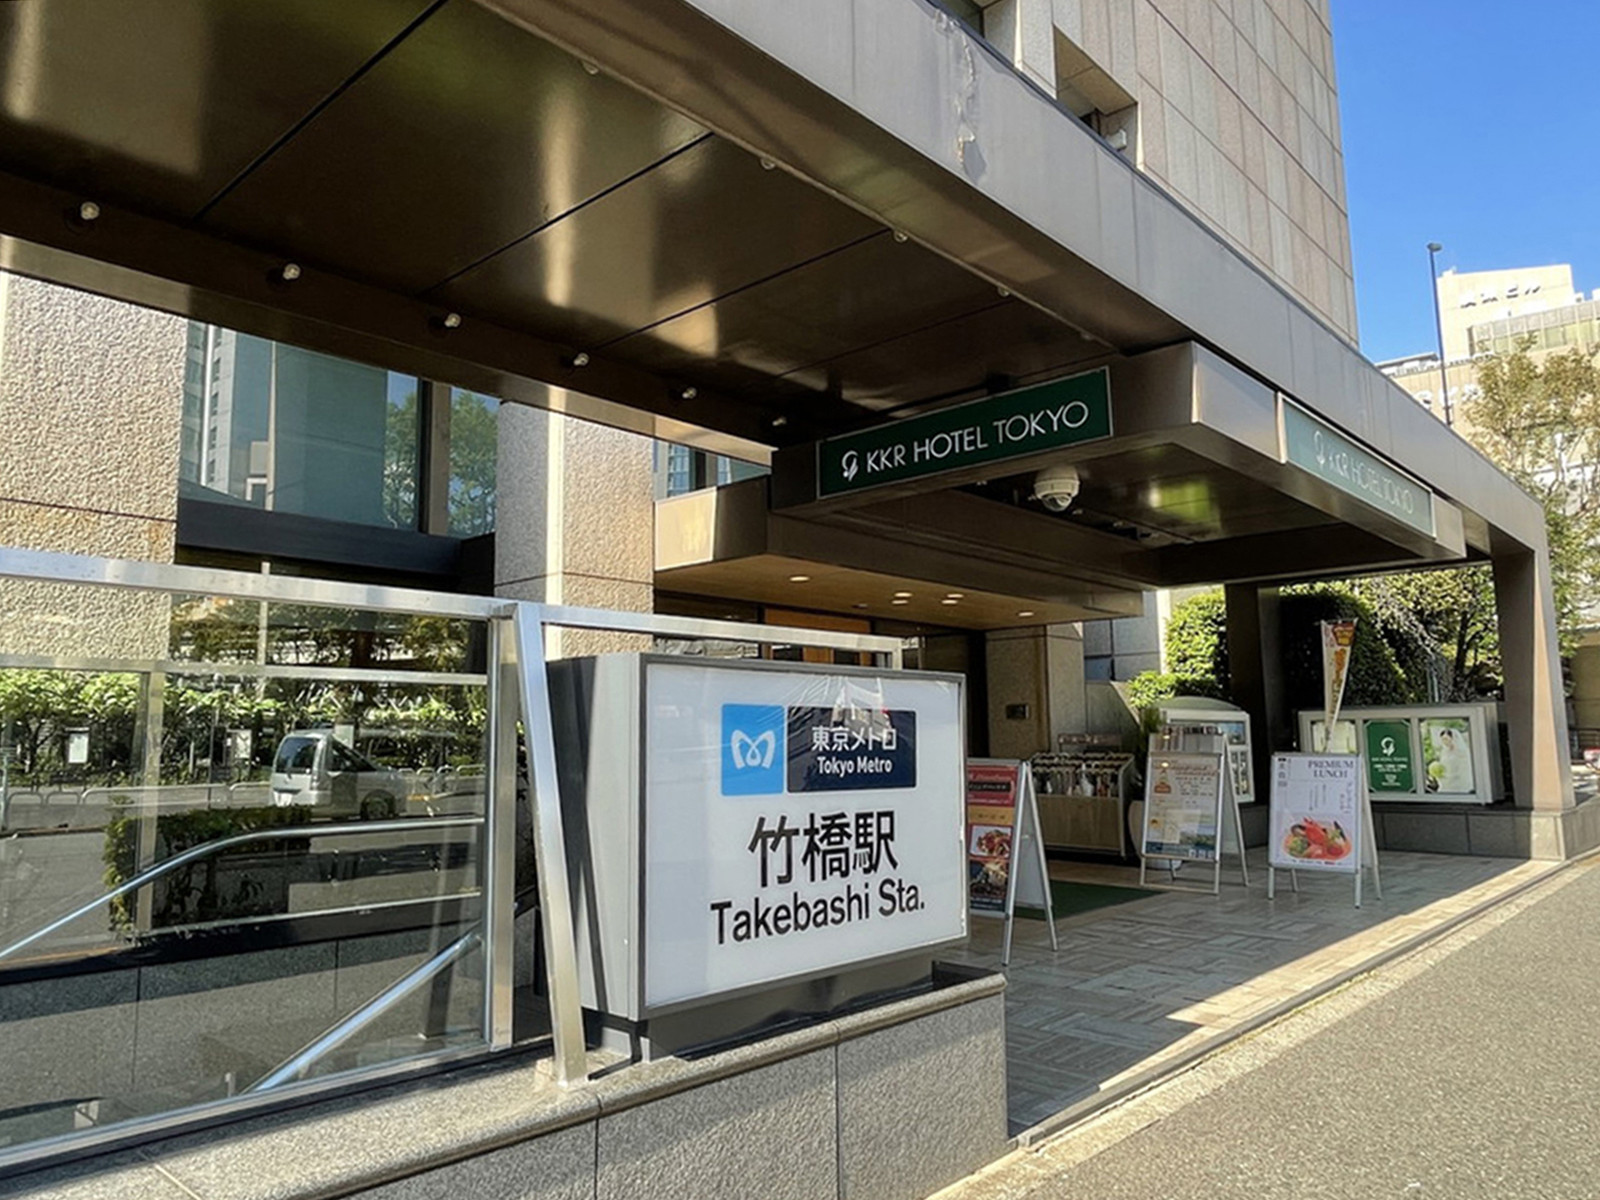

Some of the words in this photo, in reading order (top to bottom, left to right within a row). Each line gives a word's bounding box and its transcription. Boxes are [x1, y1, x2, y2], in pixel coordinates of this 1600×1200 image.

[866, 444, 907, 473] KKR
[913, 426, 988, 463] HOTEL
[993, 400, 1089, 441] TOKYO
[811, 726, 897, 751] 東京メトロ
[817, 756, 855, 778] Tokyo
[857, 756, 893, 774] Metro
[1308, 759, 1354, 769] PREMIUM
[1314, 769, 1348, 779] LUNCH
[747, 810, 899, 888] 竹橋駅
[710, 883, 870, 945] Takebashi
[878, 877, 926, 918] Sta.
